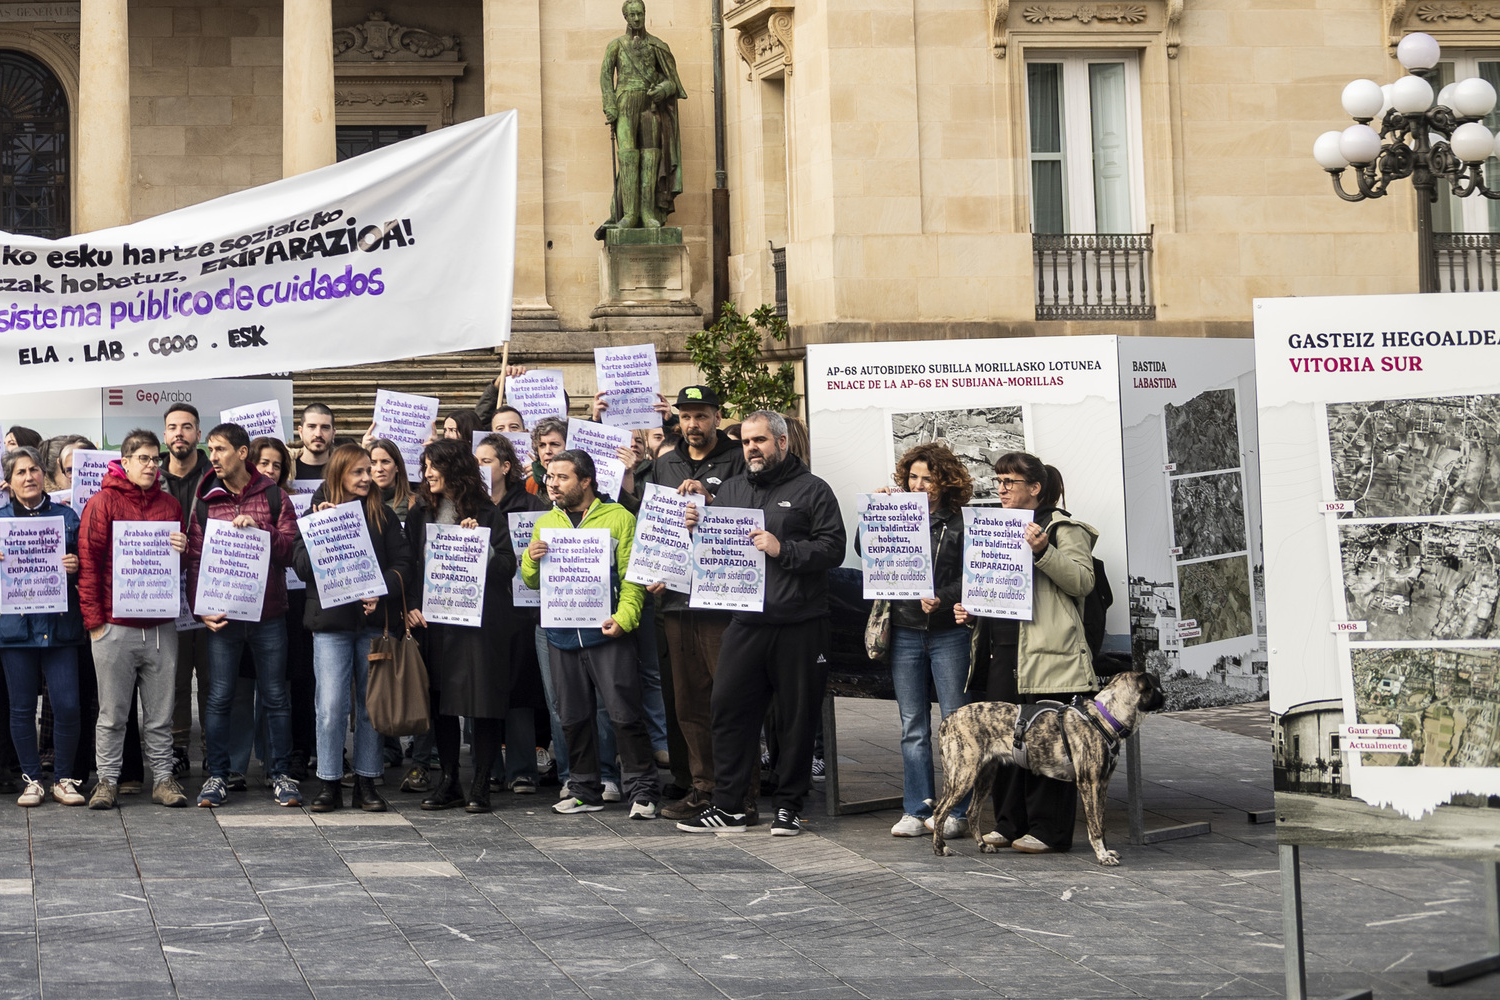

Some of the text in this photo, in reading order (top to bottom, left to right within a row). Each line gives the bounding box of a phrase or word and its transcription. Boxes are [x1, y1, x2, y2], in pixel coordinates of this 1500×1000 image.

[46, 243, 113, 268] esku
[123, 241, 215, 266] hartze
[219, 208, 344, 254] sozialeko
[60, 270, 187, 295] hobetuz,
[18, 325, 268, 365] ELA LAB CCOO ESK
[1288, 332, 1375, 349] GASTEIZ
[827, 360, 1102, 376] AP-68 AUTOBIDEKO SUBILLA MORILLASKO LOTUNEA
[1132, 361, 1167, 372] BASTIDA
[1289, 356, 1423, 373] VITORIA SUR
[826, 376, 1064, 390] ENLACE DE LA AP-68 EN SUBIJANA-MORILLAS
[1133, 377, 1177, 389] LABASTIDA
[135, 388, 192, 405] GeoAraba
[1325, 503, 1345, 511] 1932
[888, 513, 922, 521] sozialeko
[974, 518, 1021, 527] Arabako esku
[880, 524, 919, 532] baldintzak
[969, 527, 991, 536] hartze
[878, 535, 910, 543] hobetuz,
[985, 540, 1022, 549] baldintzak
[981, 550, 1011, 560] hobetuz,
[970, 561, 1023, 571] EKIPARAZIOA!
[1337, 623, 1357, 631] 1968
[1348, 727, 1394, 738] Gaur egun
[1349, 740, 1408, 750] Actualmente
